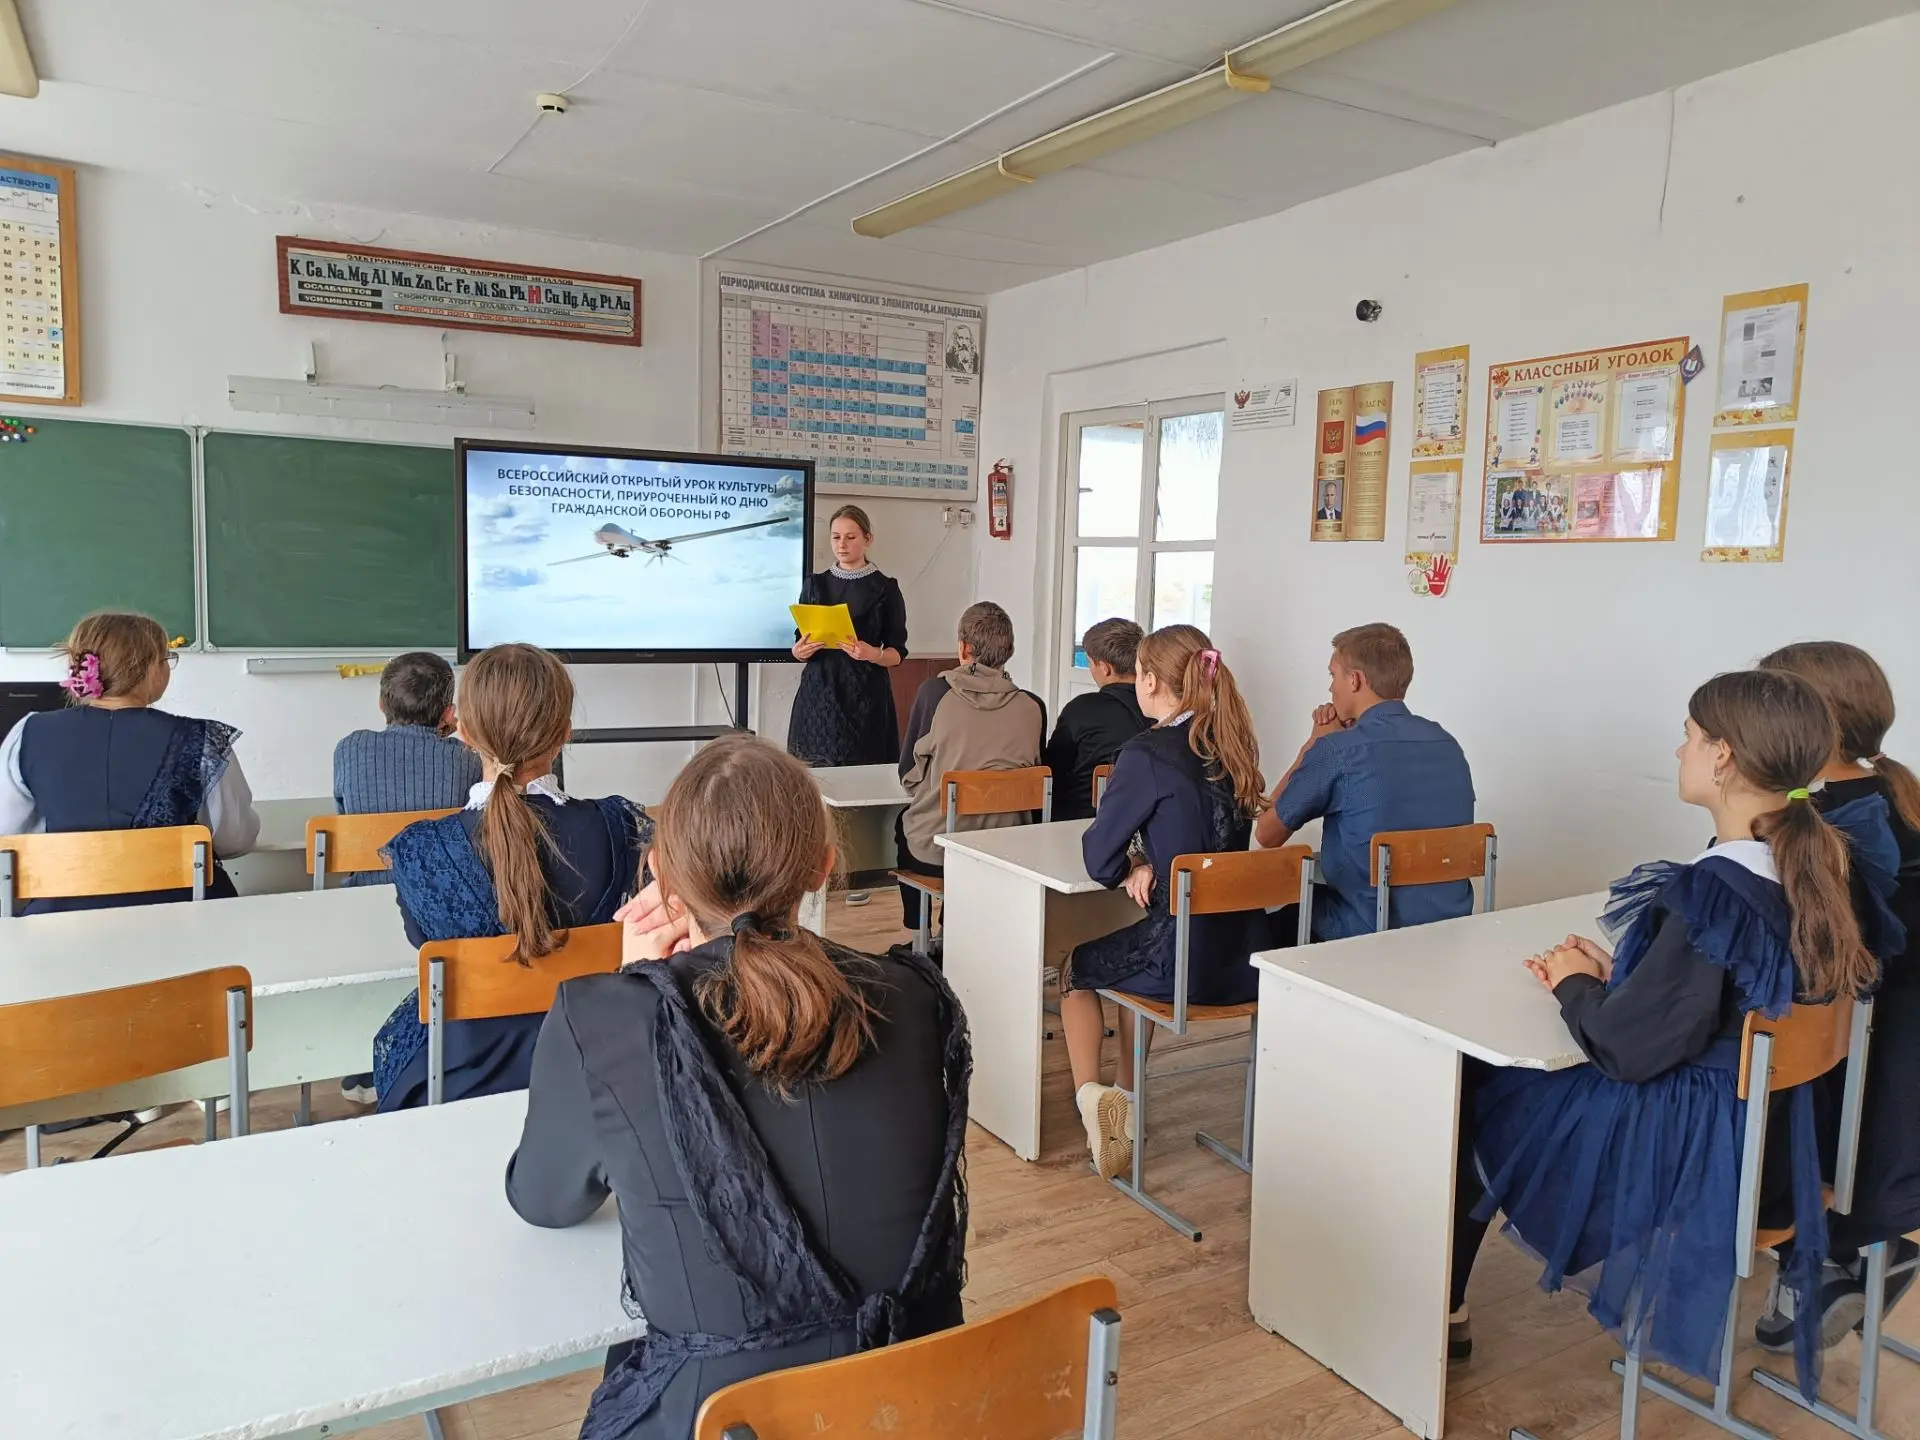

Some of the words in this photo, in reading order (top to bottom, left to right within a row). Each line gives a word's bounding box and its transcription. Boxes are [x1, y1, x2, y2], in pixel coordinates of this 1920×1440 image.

[304, 283, 373, 295] ОСЛАБЛЯЕТСЯ
[721, 276, 790, 293] ПЕРИОДИЧЕСКАЯ
[791, 285, 826, 298] СИСТЕМА
[828, 290, 880, 306] ХИМИЧЕСКИХ
[305, 295, 373, 307] УСИЛИВАЕТСЯ
[1514, 356, 1599, 381] КЛАССНЫЙ
[1607, 348, 1675, 369] УГОЛОК
[497, 468, 609, 485] ВСЕРОССИЙСКИЙ
[611, 474, 681, 488] ОТКРЫТЫЙ
[684, 479, 715, 491] УРОК
[718, 481, 777, 494] КУЛЬТУРЫ
[509, 485, 614, 501] БЕЗОПАСНОСТИ,
[617, 490, 718, 505] ПРИУРОЧЕННЫЙ
[721, 495, 737, 506] КО
[739, 497, 768, 508] ДНЮ
[551, 502, 647, 517] ГРАЖДАНСКОЙ
[650, 507, 711, 519] ОБОРОНЫ
[714, 510, 731, 520] РФ
[998, 519, 1004, 527] 4
